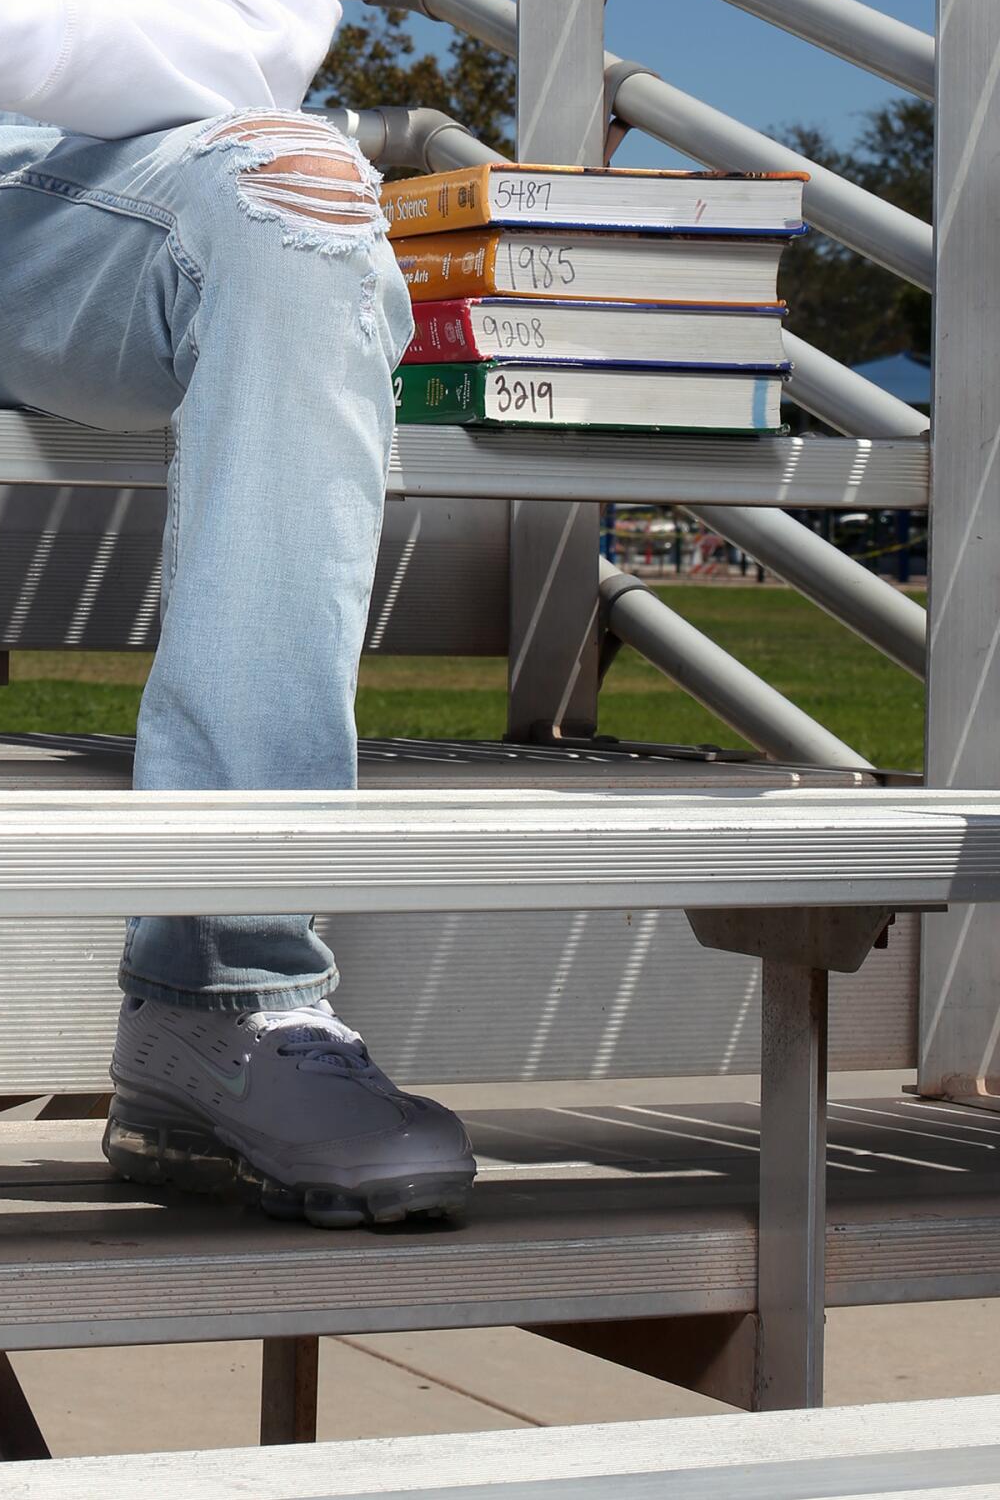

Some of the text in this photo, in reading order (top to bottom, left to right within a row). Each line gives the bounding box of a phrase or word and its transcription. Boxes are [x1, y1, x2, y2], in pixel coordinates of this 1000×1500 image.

[397, 195, 428, 220] Science
[494, 180, 551, 211] 5487
[413, 269, 429, 283] Arts
[508, 243, 575, 290] 1985
[483, 315, 545, 348] 9208
[393, 376, 403, 407] 2
[495, 374, 553, 419] 3219
